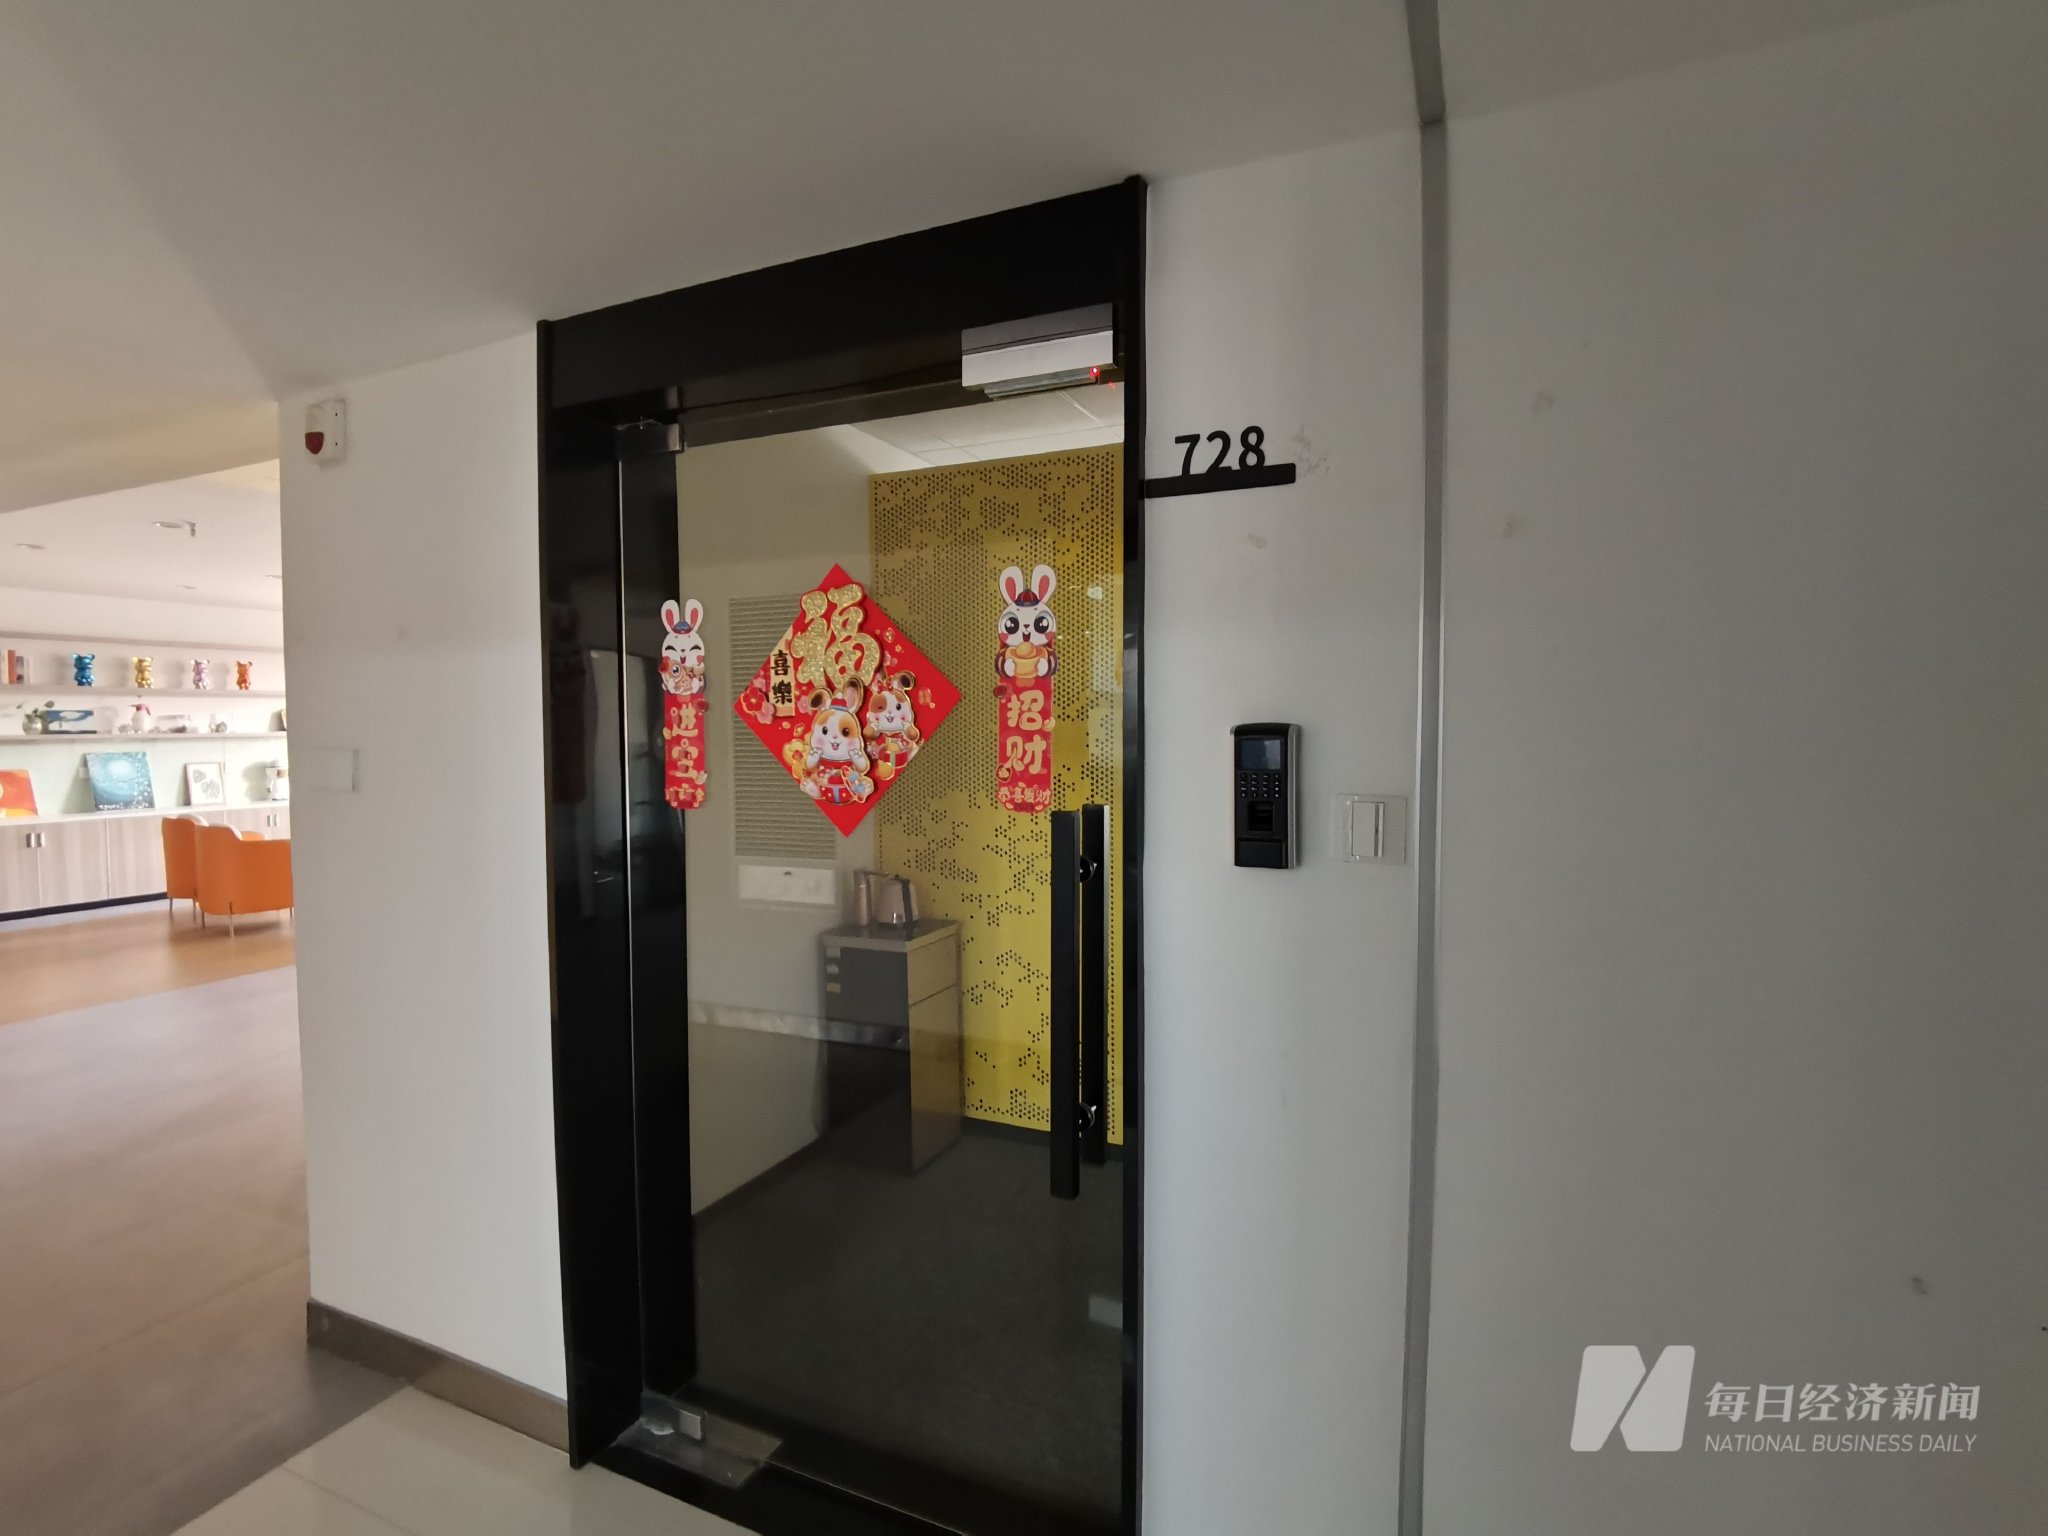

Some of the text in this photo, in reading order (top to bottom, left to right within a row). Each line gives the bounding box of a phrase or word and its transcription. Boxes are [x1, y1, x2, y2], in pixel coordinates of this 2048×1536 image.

[1174, 425, 1266, 477] 728
[791, 583, 881, 691] 福
[770, 649, 793, 705] 喜樂
[1006, 690, 1047, 775] 招财
